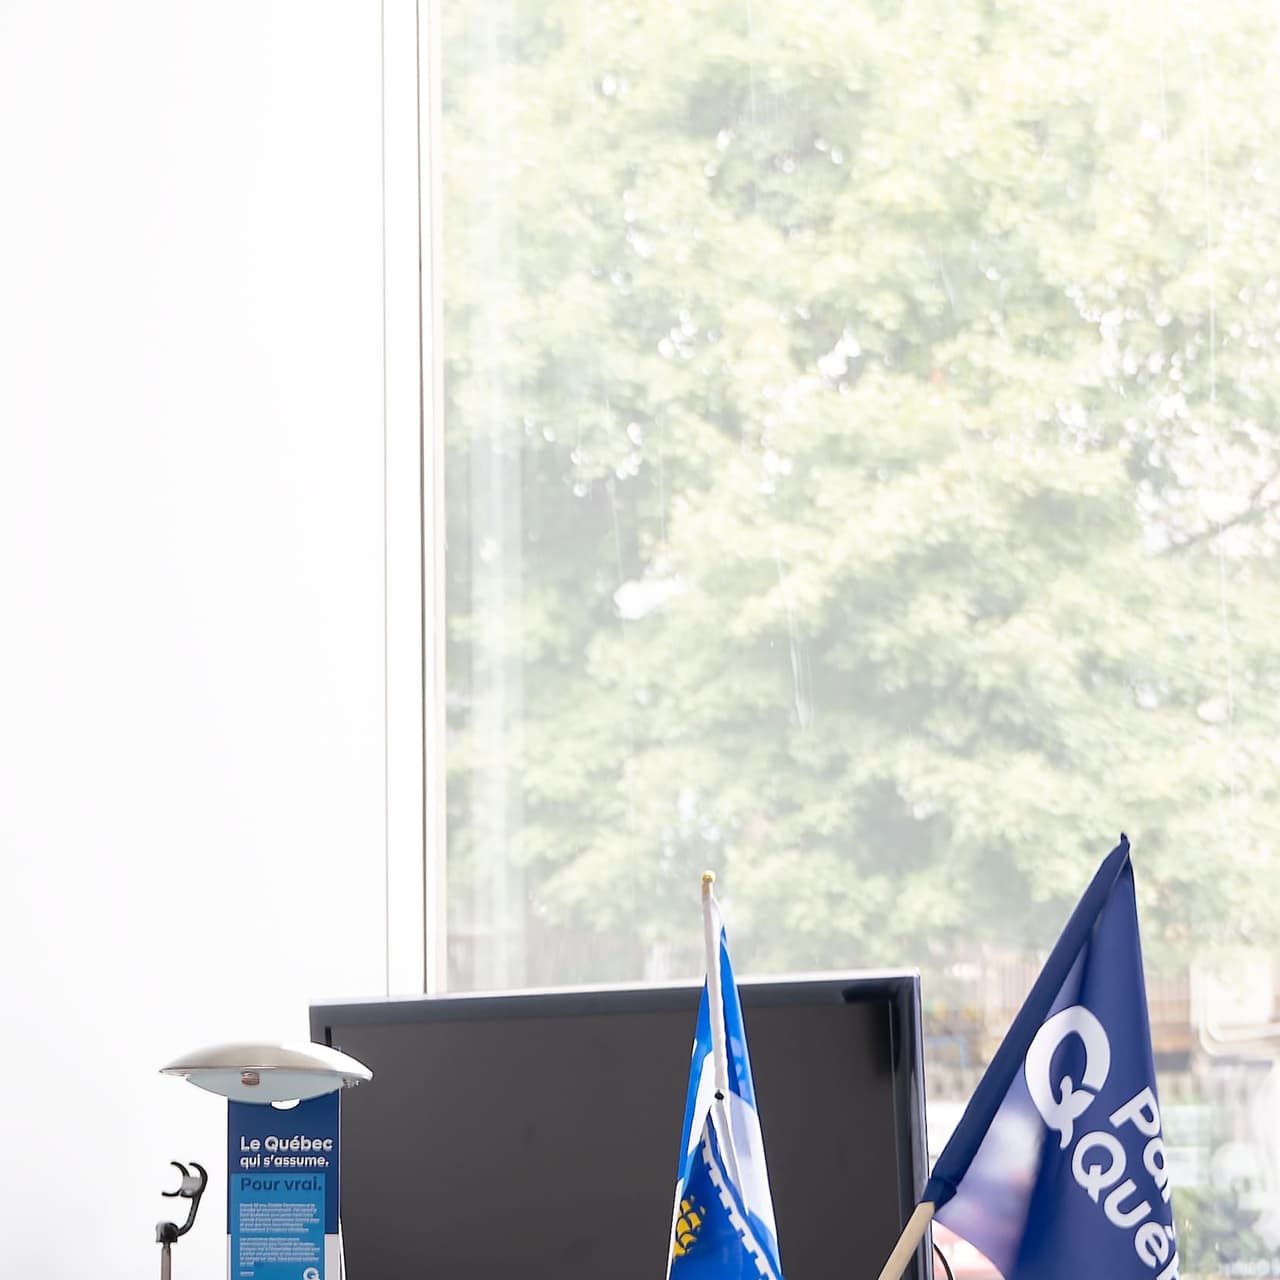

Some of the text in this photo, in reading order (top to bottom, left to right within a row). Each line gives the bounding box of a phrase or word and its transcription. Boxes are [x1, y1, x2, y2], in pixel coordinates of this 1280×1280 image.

[240, 1135, 333, 1153] Le Québec
[240, 1153, 329, 1170] qui s'assume.
[240, 1176, 323, 1191] Pour vrai.
